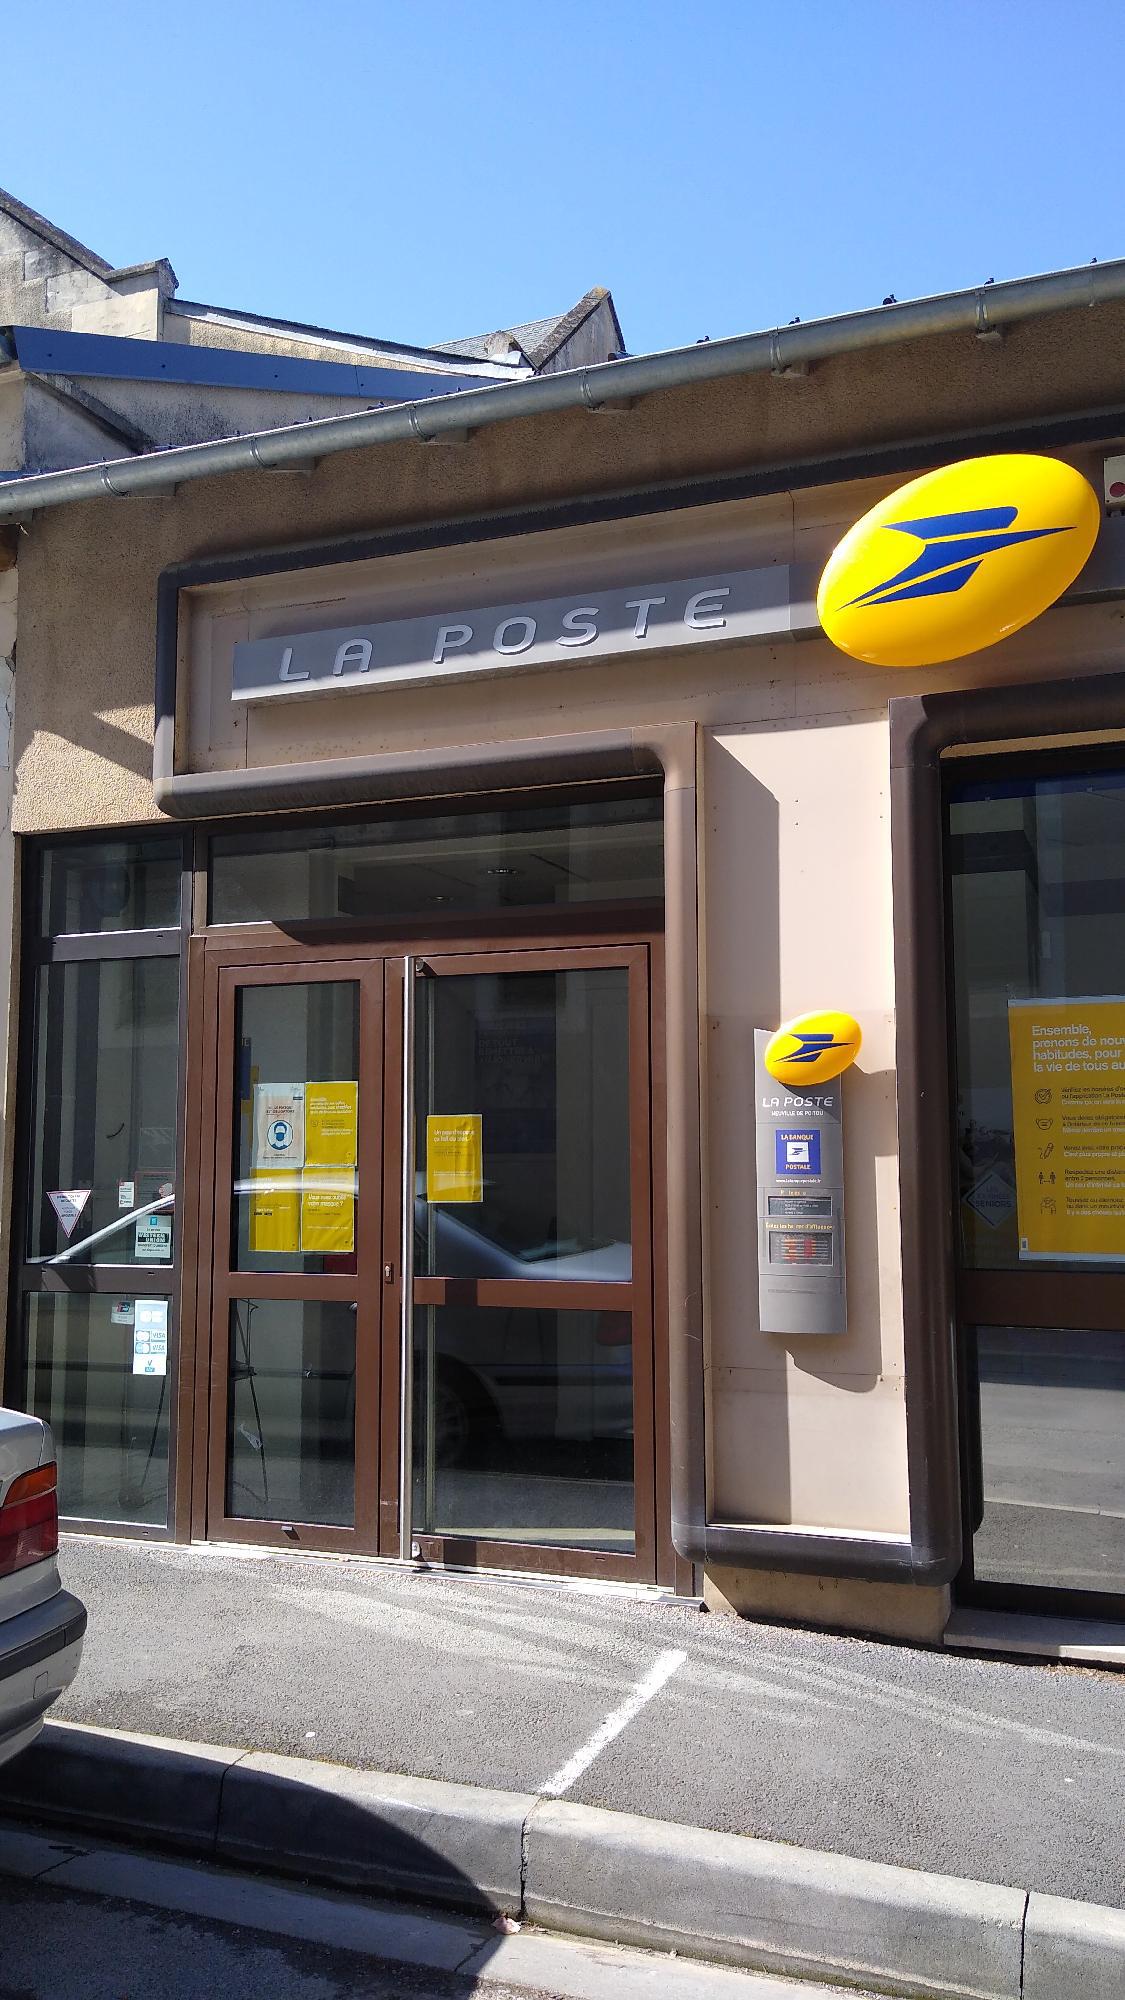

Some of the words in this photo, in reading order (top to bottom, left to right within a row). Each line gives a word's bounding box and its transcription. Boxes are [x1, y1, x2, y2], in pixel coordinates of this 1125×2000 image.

[279, 638, 374, 682] LA
[432, 587, 731, 664] POSTE
[1031, 1024, 1092, 1036] Ensemble,
[1032, 1039, 1080, 1050] prenons
[1082, 1036, 1097, 1047] de
[1032, 1048, 1092, 1060] habitudes,
[1095, 1050, 1122, 1060] pour
[1033, 1062, 1044, 1072] la
[1047, 1062, 1063, 1072] vie
[1065, 1061, 1081, 1071] de
[1083, 1061, 1109, 1071] tous
[762, 1097, 780, 1107] LA
[784, 1096, 834, 1107] POSTE
